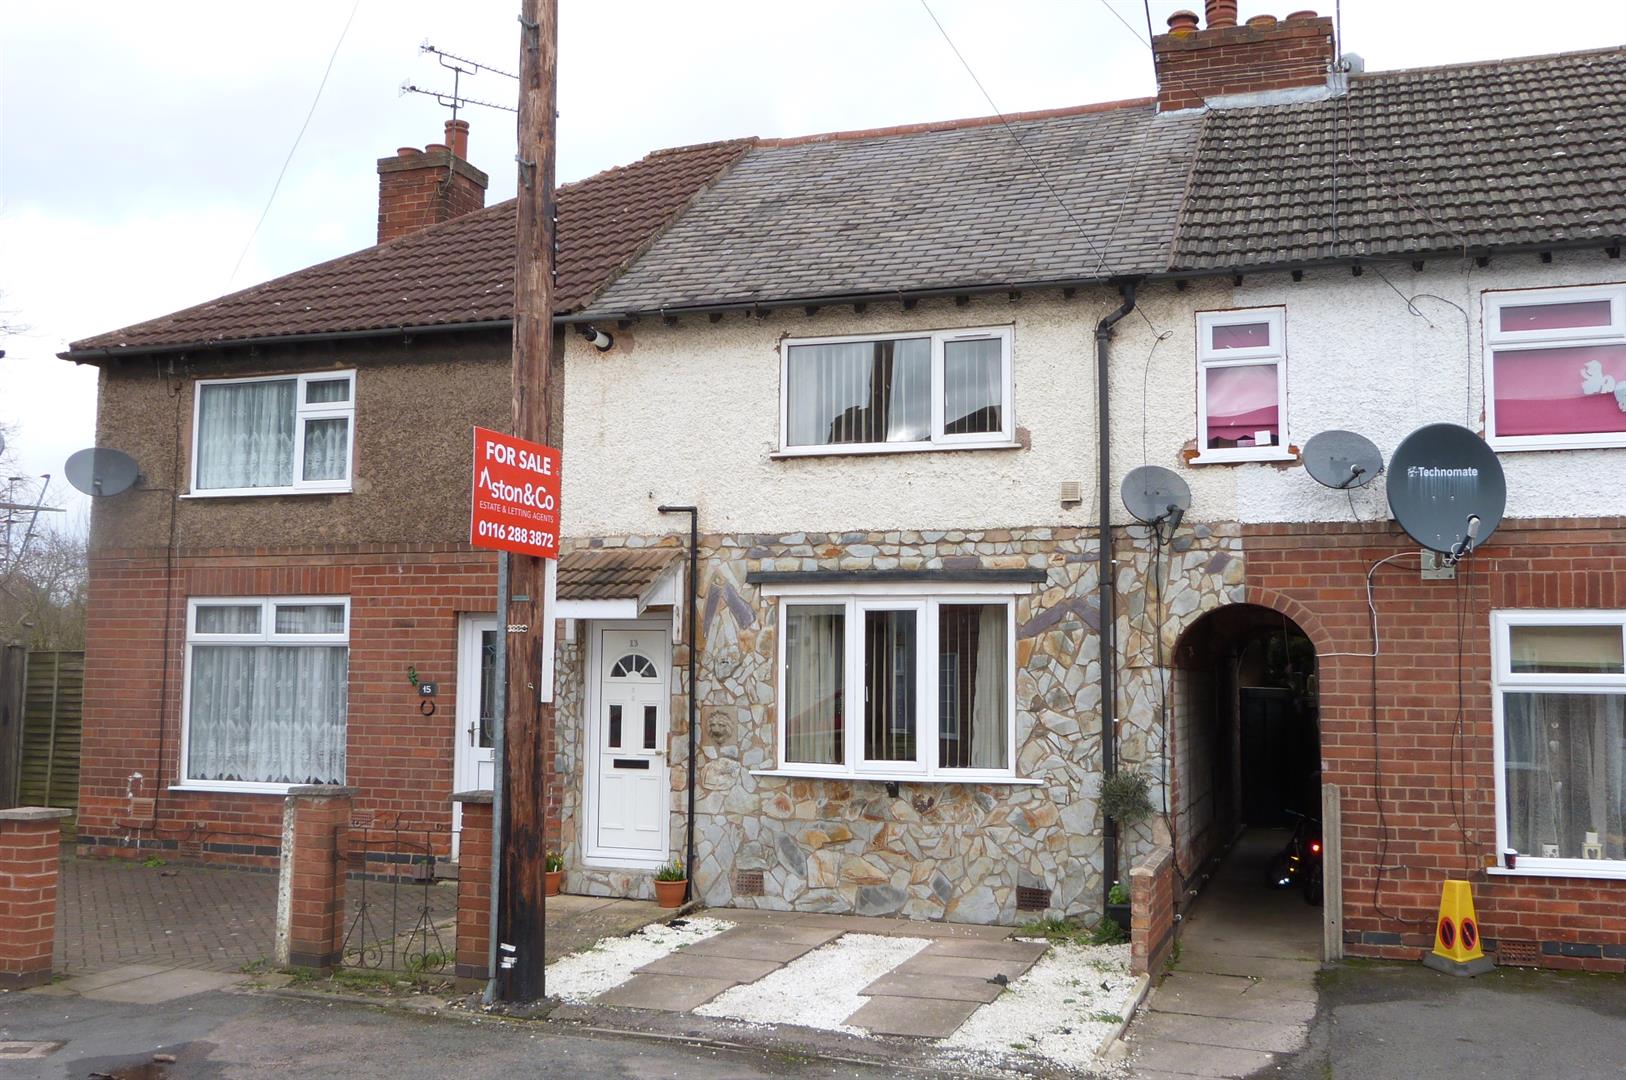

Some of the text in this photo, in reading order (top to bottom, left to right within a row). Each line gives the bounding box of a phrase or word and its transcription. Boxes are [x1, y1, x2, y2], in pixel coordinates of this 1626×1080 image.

[486, 441, 551, 476] FOR SALE
[1418, 466, 1479, 477] Technomate
[479, 466, 554, 511] Aston&Co
[480, 500, 554, 524] ESTATE & LETTING AGENTS
[479, 520, 554, 548] 0116 288 3872
[422, 685, 432, 694] 15
